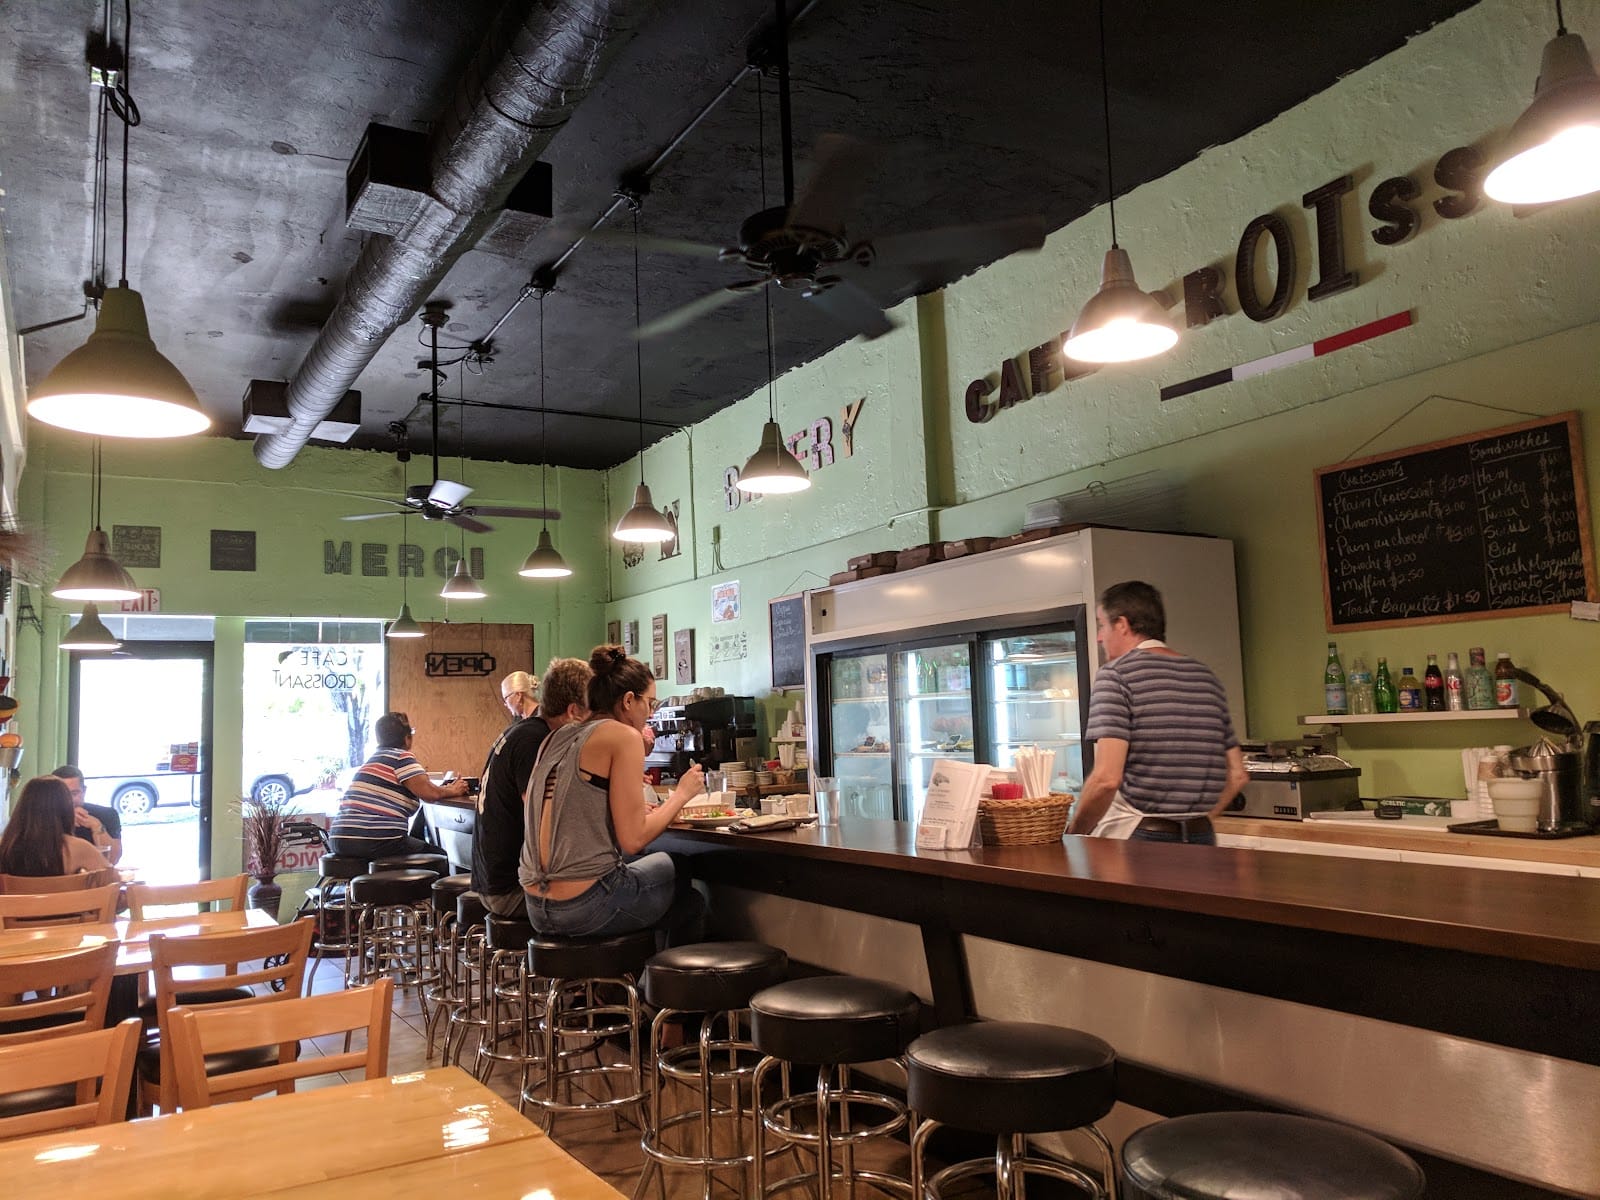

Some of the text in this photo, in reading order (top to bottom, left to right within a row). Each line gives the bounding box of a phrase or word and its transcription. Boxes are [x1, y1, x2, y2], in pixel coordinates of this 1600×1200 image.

[965, 329, 1104, 424] CAF
[724, 398, 863, 512] BERY
[1333, 494, 1370, 515] Plain
[1374, 478, 1436, 507] Croissant
[324, 540, 485, 580] MERCI
